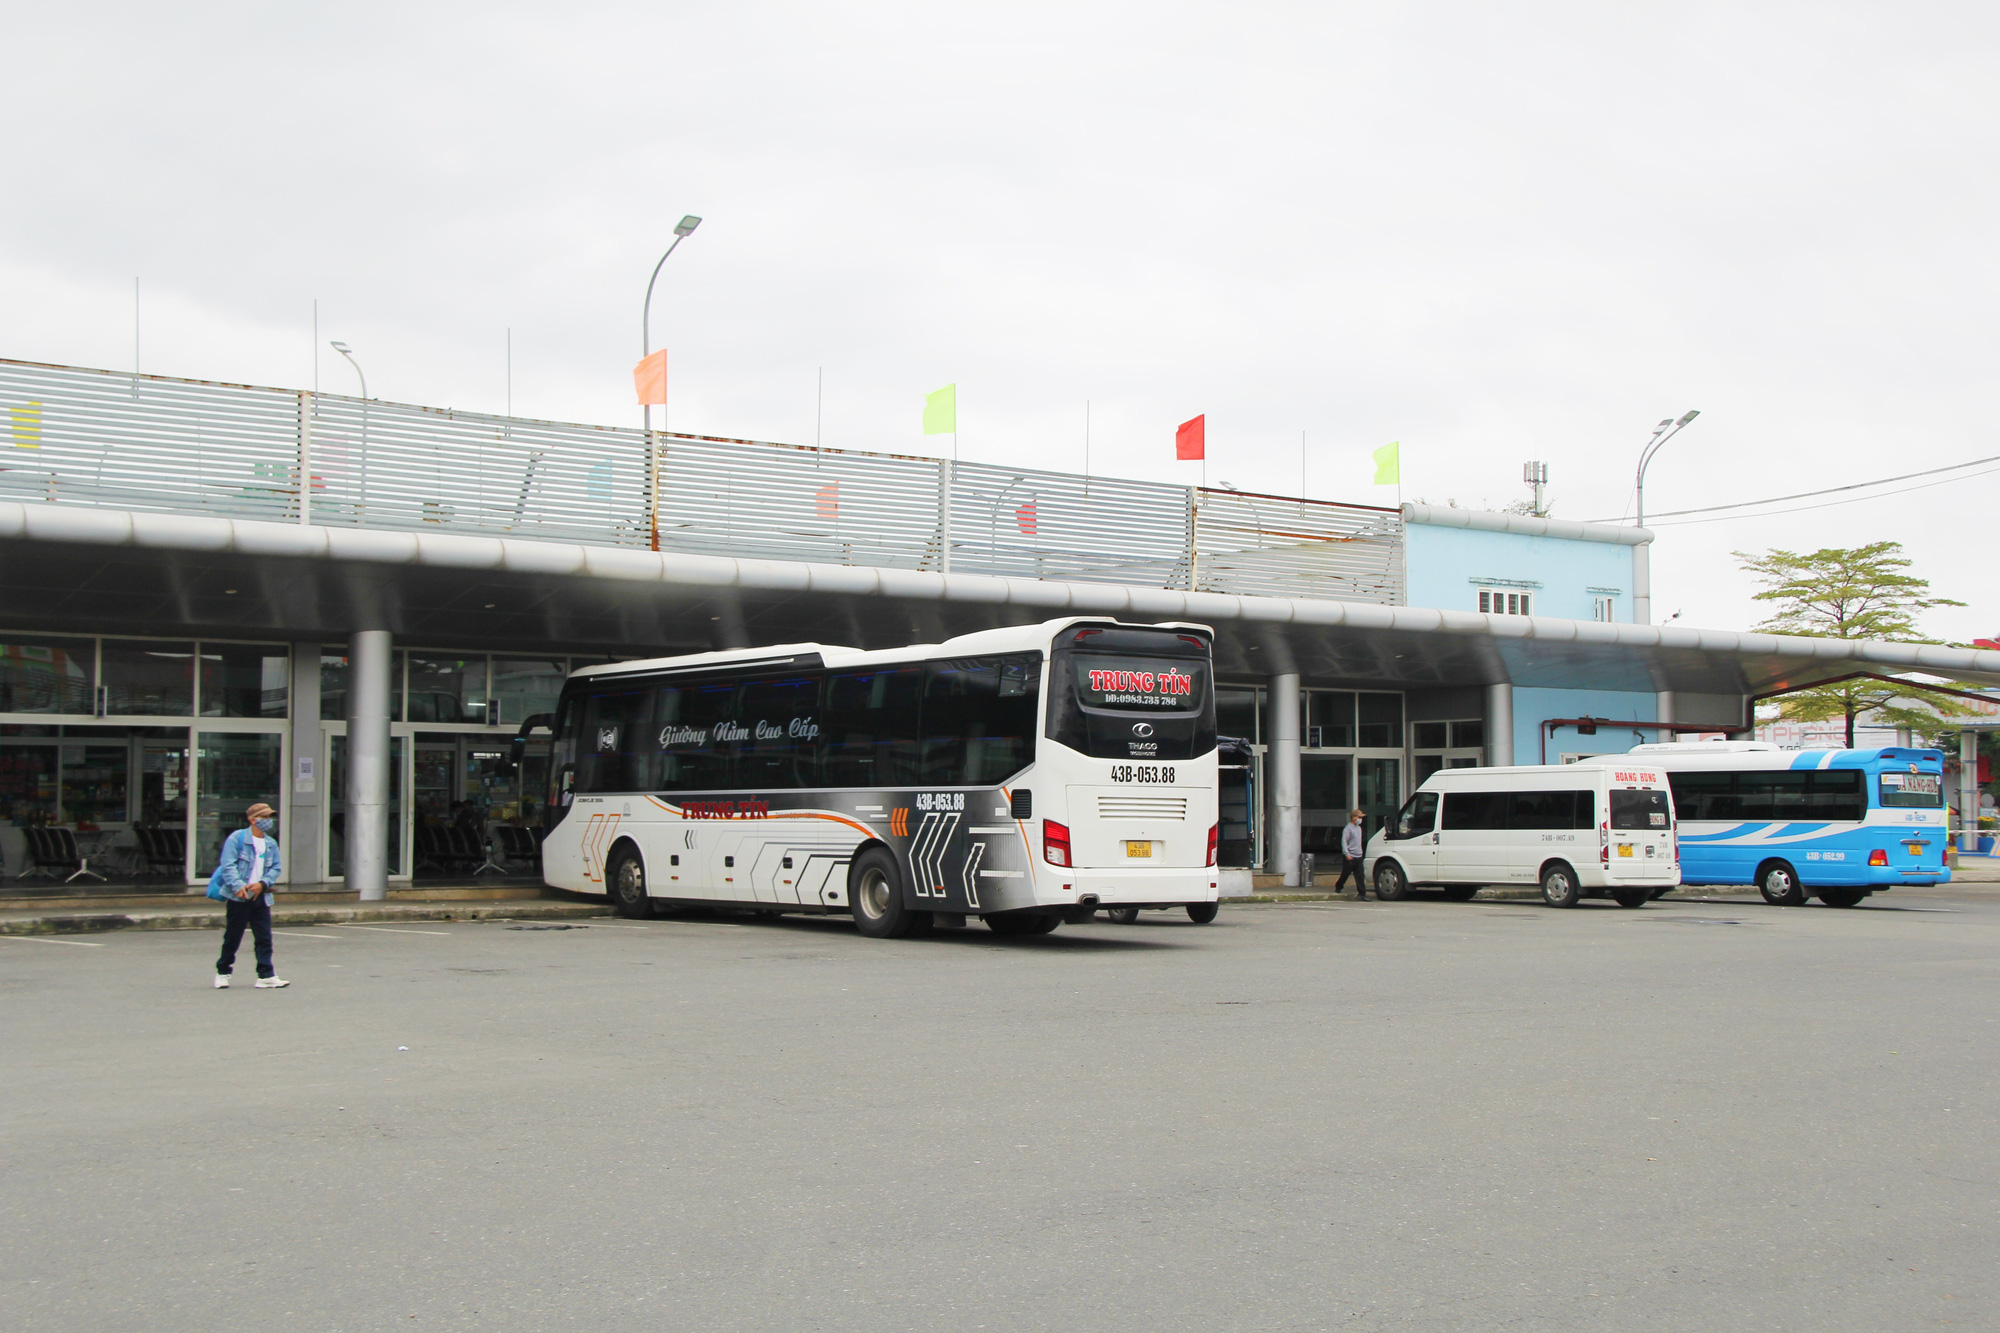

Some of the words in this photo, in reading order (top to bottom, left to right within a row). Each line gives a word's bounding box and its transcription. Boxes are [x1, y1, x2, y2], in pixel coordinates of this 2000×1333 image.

[1089, 669, 1155, 693] TRUNG
[1158, 667, 1191, 695] TÍN
[1161, 696, 1177, 706] 786
[755, 719, 783, 740] Cao
[788, 716, 820, 741] Cấp
[1128, 742, 1158, 750] THACO
[1111, 765, 1175, 783] 43B-053.88
[680, 801, 735, 820] TRUNG
[738, 795, 769, 820] TÍN
[916, 793, 965, 811] 43B-053.88
